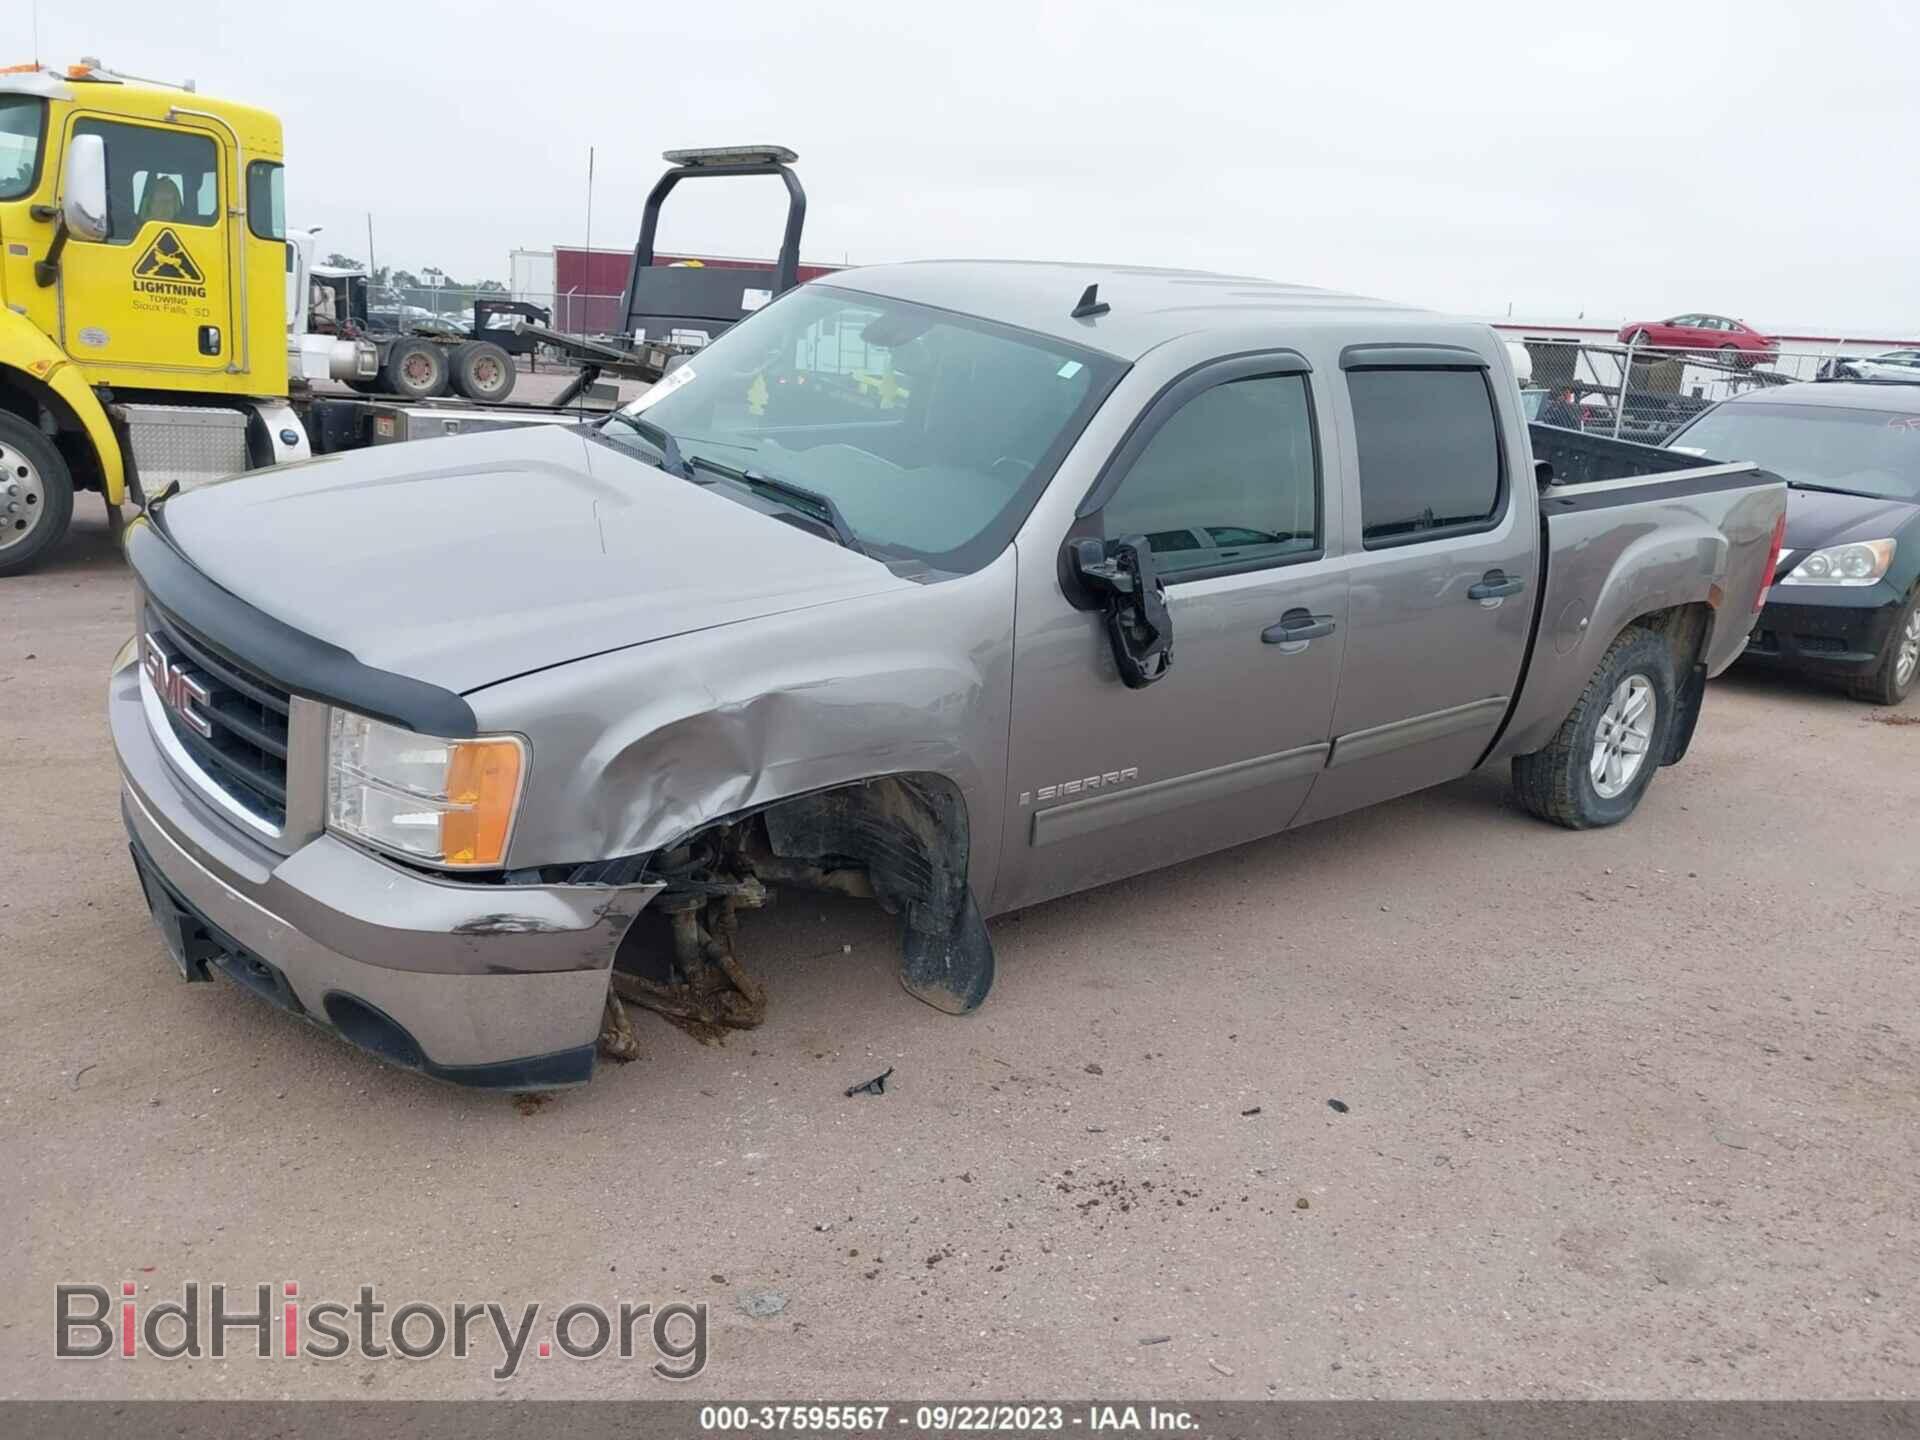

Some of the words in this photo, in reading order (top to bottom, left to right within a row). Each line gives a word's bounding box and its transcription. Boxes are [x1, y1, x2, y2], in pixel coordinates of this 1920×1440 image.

[133, 280, 207, 298] LIGHTNING
[132, 299, 161, 312] Sioux
[193, 307, 210, 318] SD
[149, 294, 188, 306] TOWING
[143, 632, 212, 738] GMC
[1037, 767, 1139, 801] SIERRA
